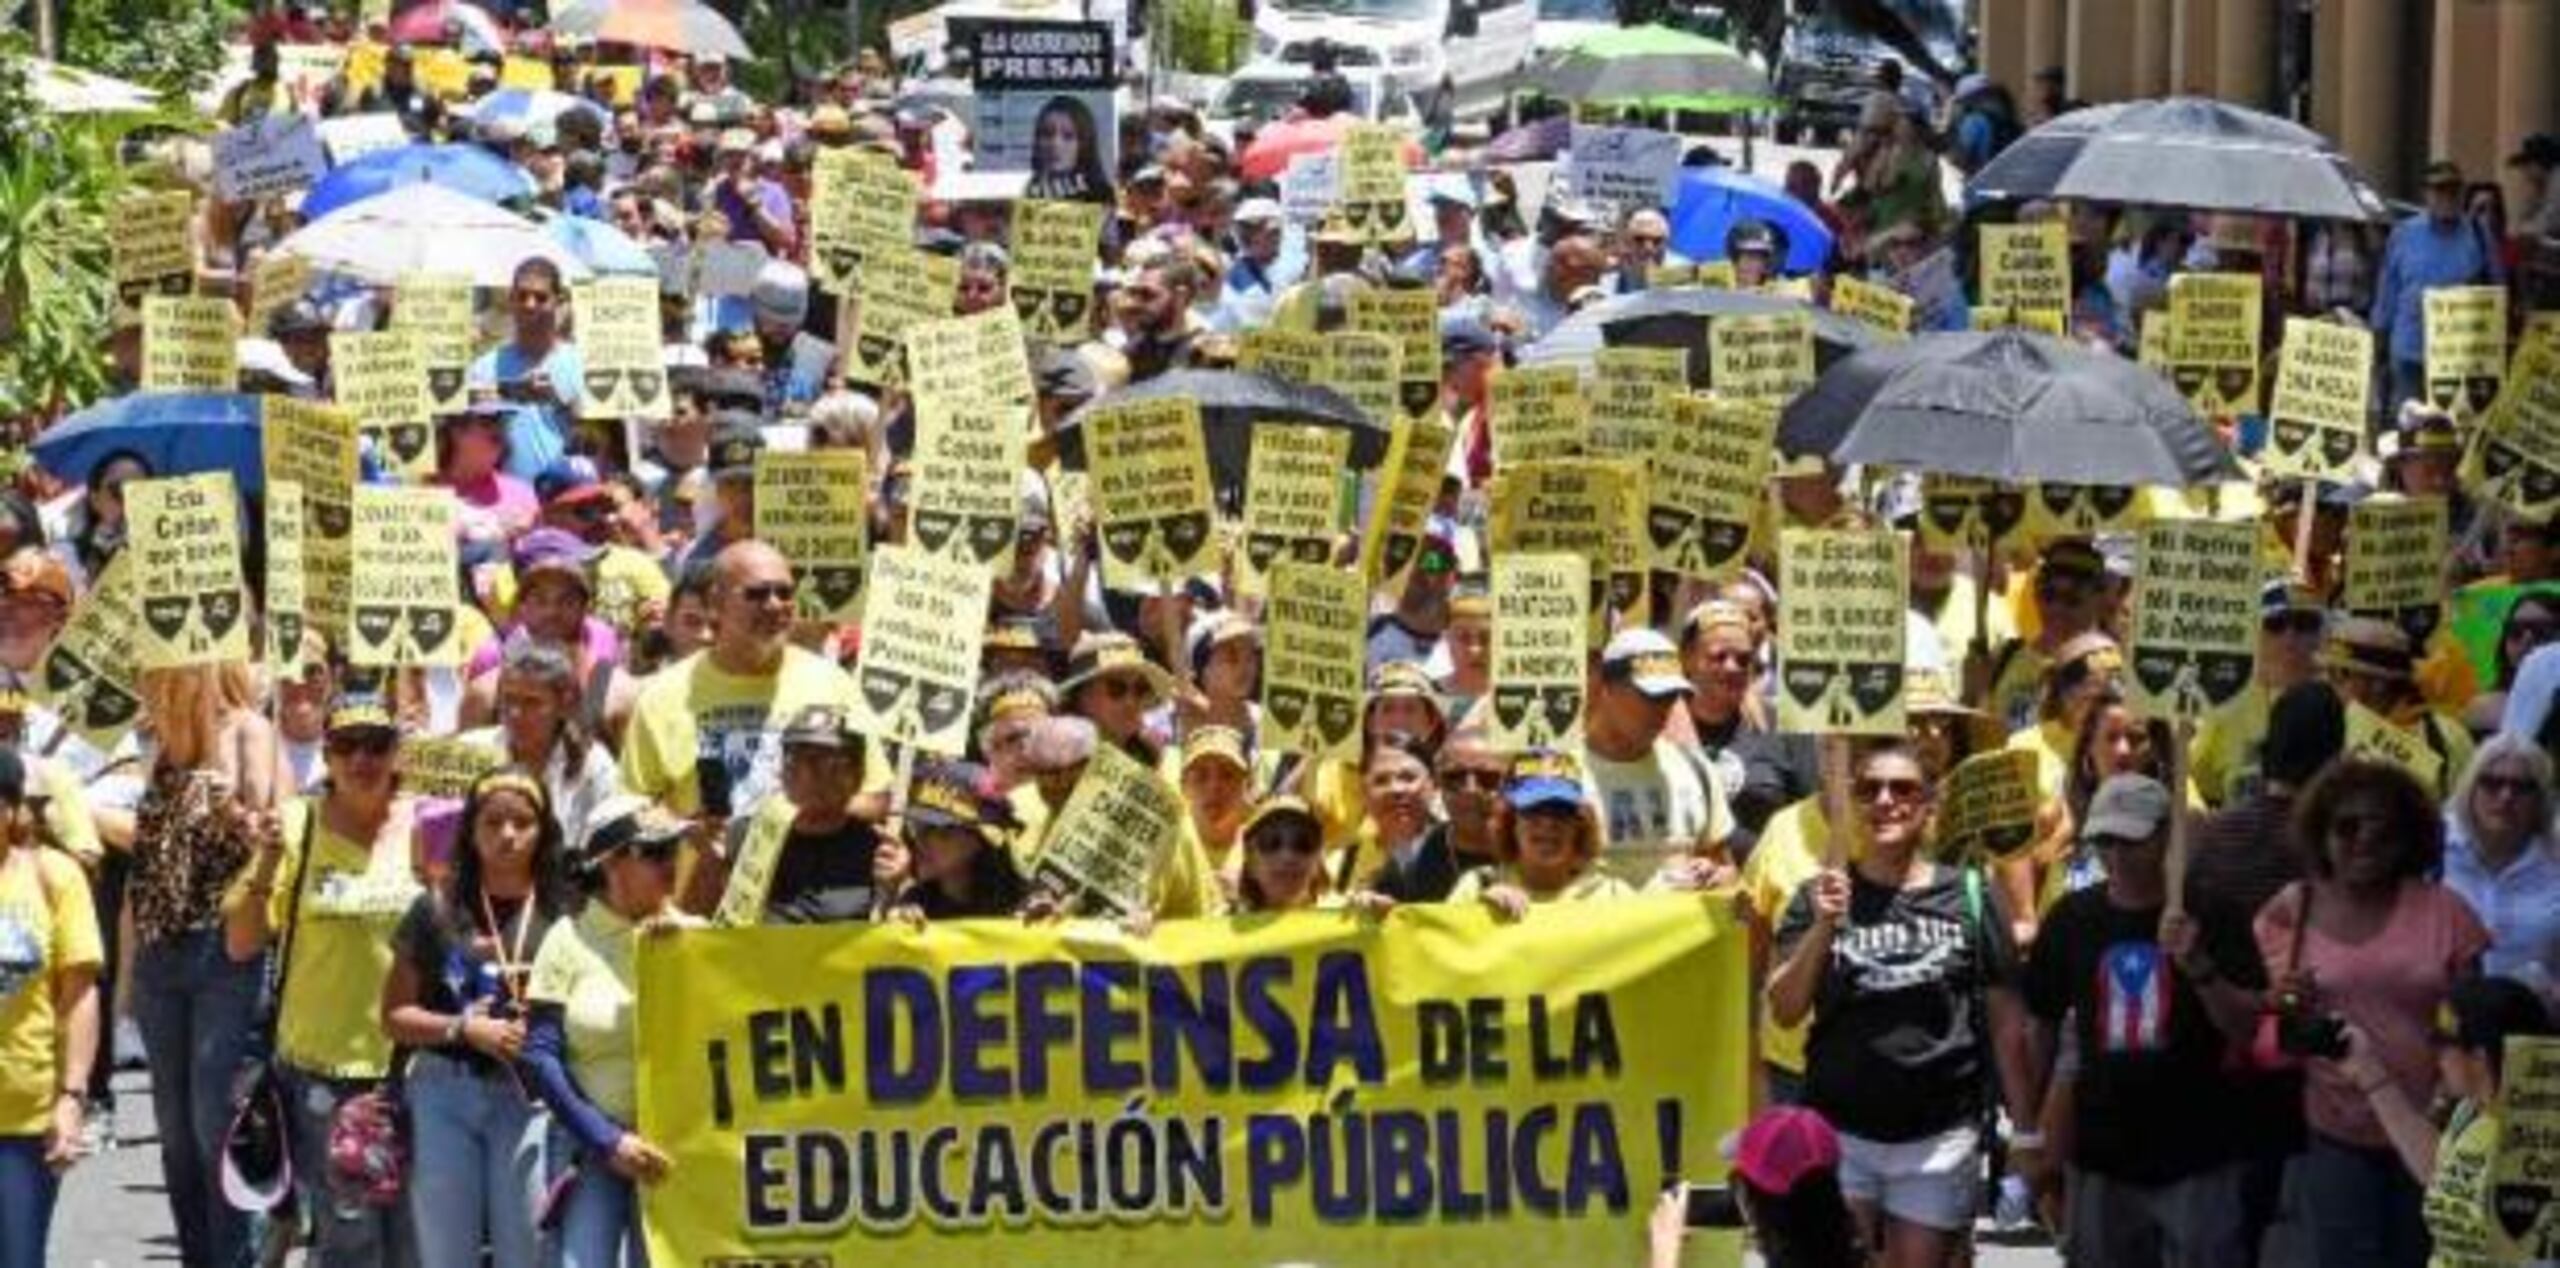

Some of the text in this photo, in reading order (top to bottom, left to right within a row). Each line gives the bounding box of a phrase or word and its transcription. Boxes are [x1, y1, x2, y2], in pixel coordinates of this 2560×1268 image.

[981, 56, 1102, 79] PRESA!
[863, 948, 1387, 1108] DEFENSA
[1418, 1000, 1508, 1085] DE
[1529, 991, 1623, 1082] LA
[743, 1094, 1229, 1232] EDUCACIÓN
[1248, 1088, 1630, 1229] PÚBLICA
